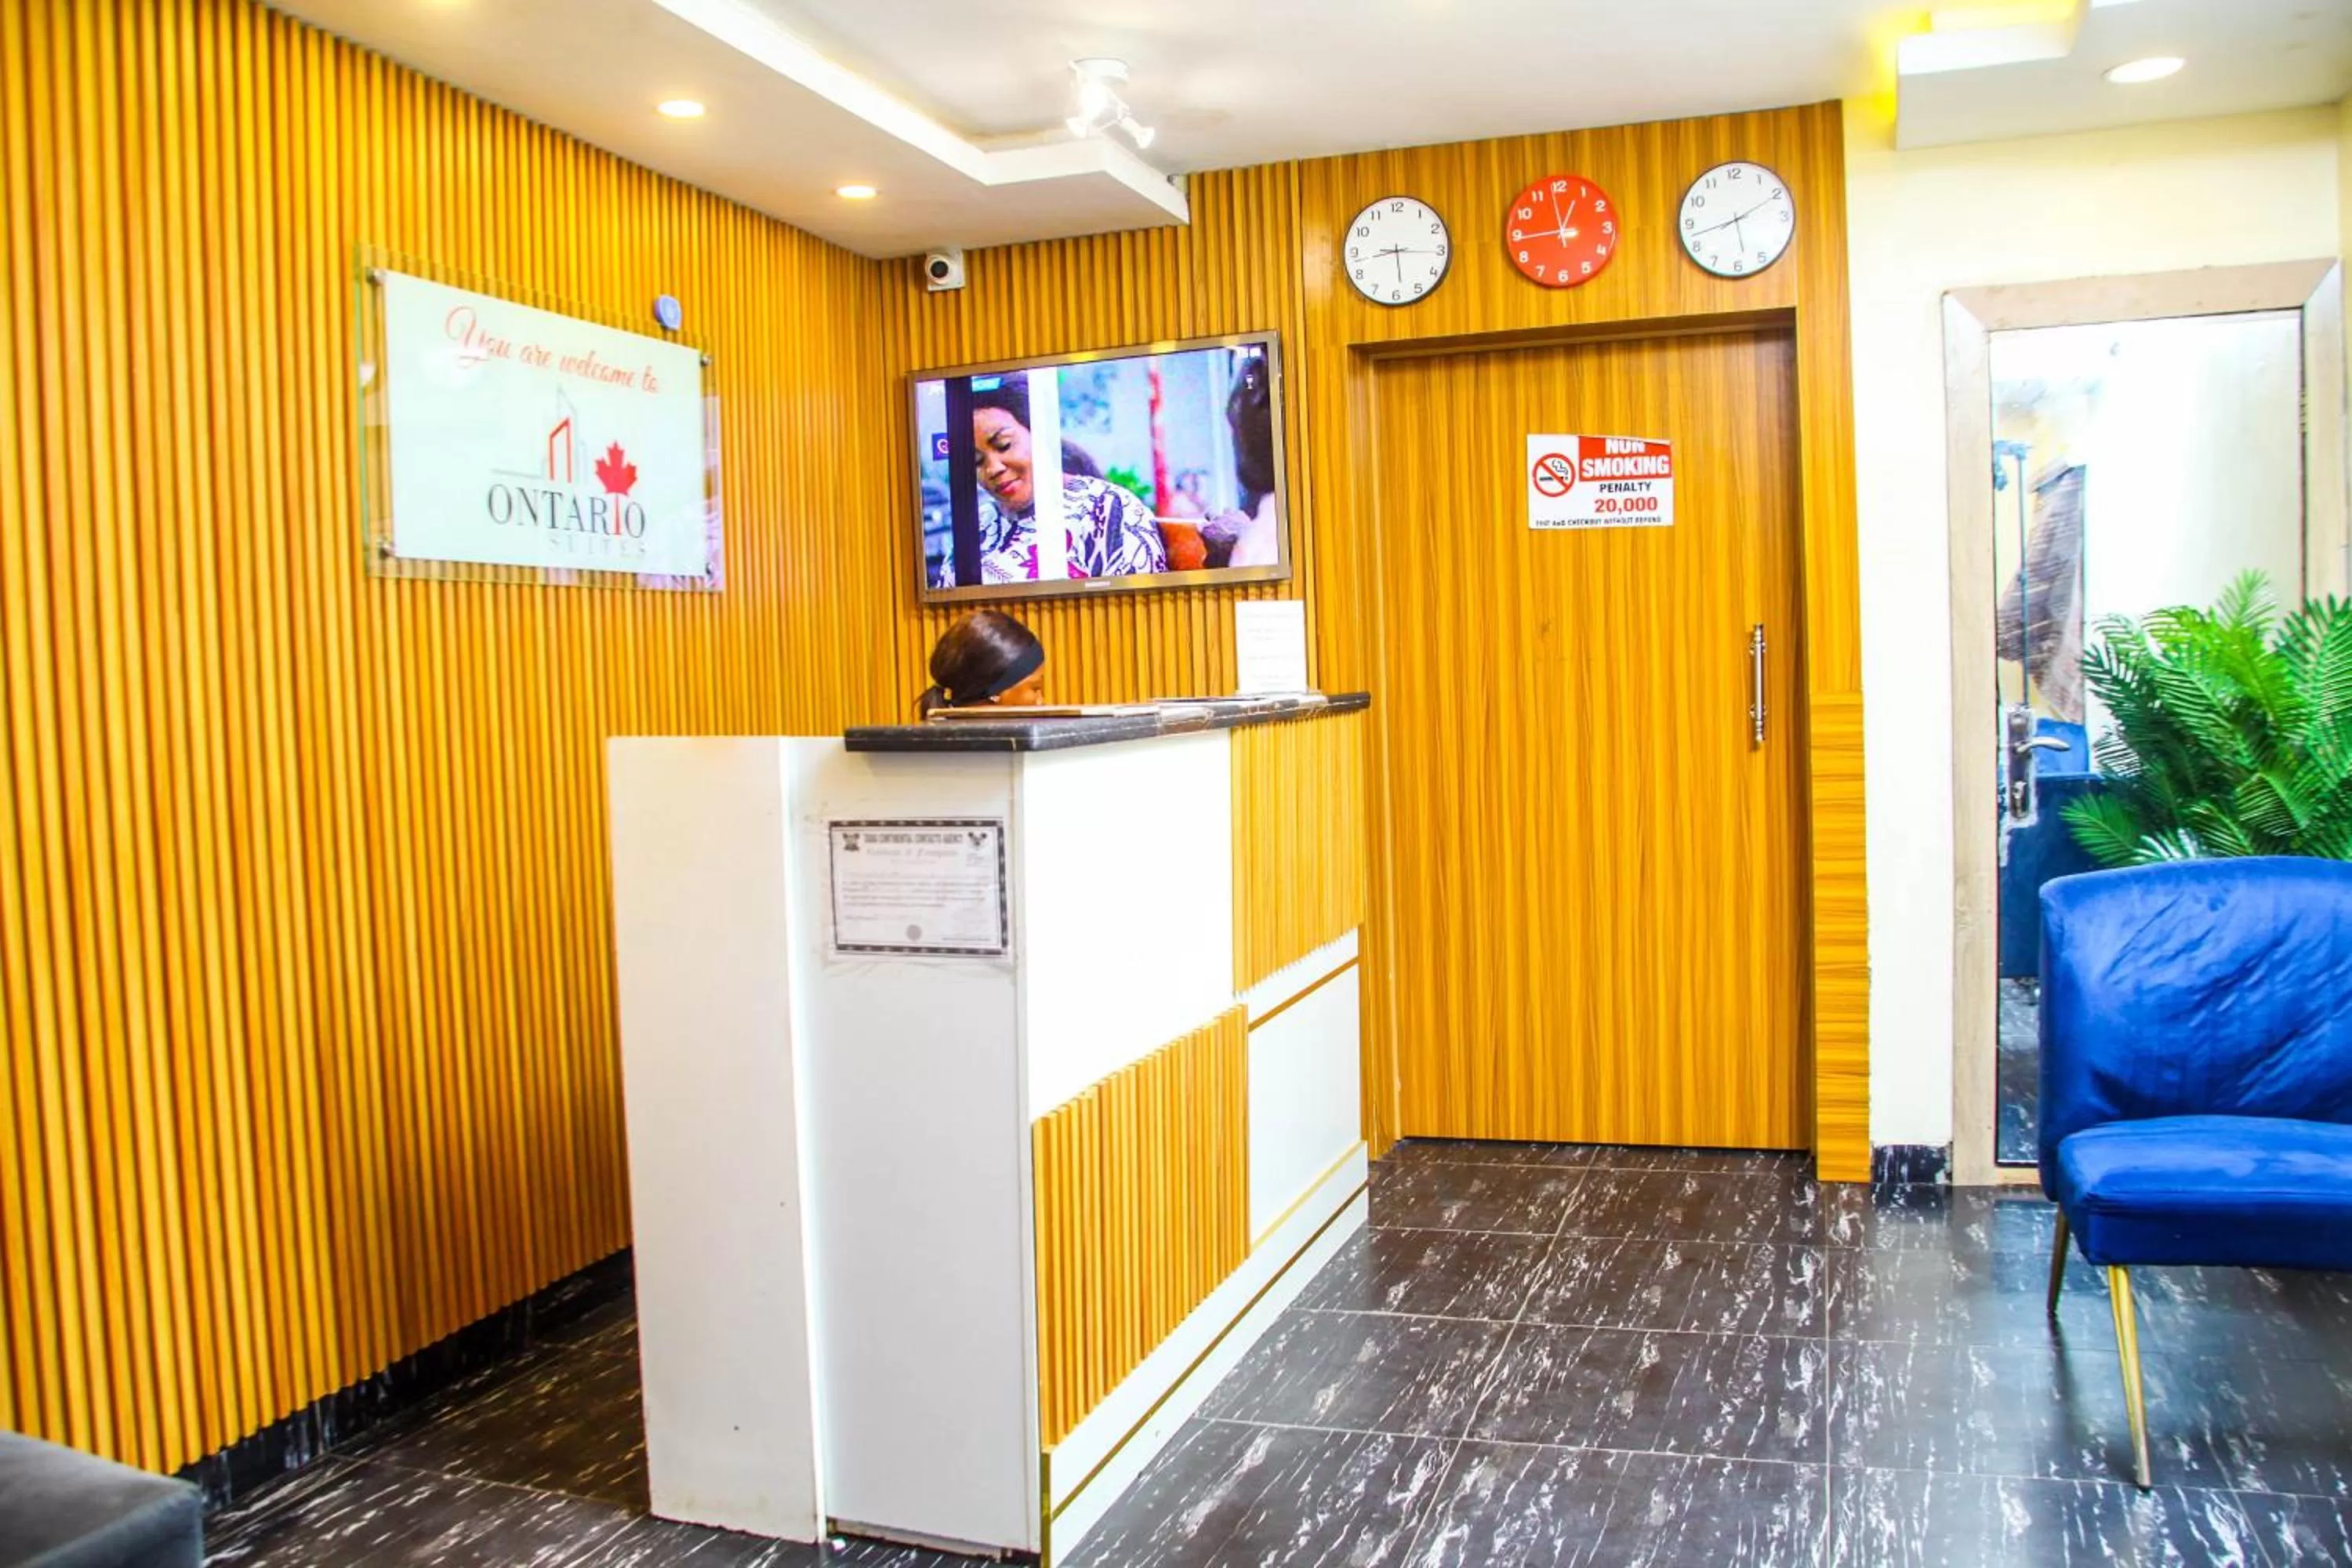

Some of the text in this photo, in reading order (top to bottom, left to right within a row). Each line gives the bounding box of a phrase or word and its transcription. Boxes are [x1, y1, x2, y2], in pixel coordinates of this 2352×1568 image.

[1726, 167, 1741, 180] 12
[1705, 177, 1717, 189] 11
[1756, 174, 1762, 186] 1
[1552, 180, 1568, 193] 12
[1581, 185, 1586, 198] 1
[1531, 190, 1544, 203] 11
[1773, 188, 1782, 200] 2
[1391, 201, 1404, 212] 12
[1595, 200, 1606, 213] 2
[1690, 195, 1705, 208] 10
[1371, 210, 1381, 220] 11
[1417, 209, 1421, 220] 1
[1518, 207, 1533, 220] 10
[1780, 210, 1789, 223] 3
[1431, 223, 1440, 234] 2
[1602, 220, 1613, 234] 3
[1685, 218, 1693, 230] 9
[1356, 226, 1370, 238] 10
[1512, 228, 1523, 242] 9
[1349, 246, 1359, 258] 9
[1436, 245, 1446, 256] 3
[1595, 244, 1606, 256] 4
[1693, 240, 1700, 252] 8
[1519, 250, 1529, 263] 8
[1710, 255, 1719, 267] 7
[1758, 252, 1766, 263] 5
[1534, 265, 1545, 277] 7
[1581, 261, 1592, 274] 5
[1733, 260, 1743, 272] 6
[1356, 269, 1363, 279] 8
[1429, 267, 1438, 278] 4
[1558, 270, 1569, 283] 6
[1371, 283, 1379, 295] 7
[1414, 283, 1423, 294] 5
[1392, 289, 1401, 301] 6
[520, 343, 552, 366] are
[558, 350, 634, 387] welcome
[641, 363, 658, 392] to
[1581, 454, 1670, 478] SMOKING
[1599, 481, 1652, 493] PENALTY
[487, 483, 646, 539] ONTARIO
[1594, 496, 1658, 515] 20,000
[1567, 517, 1602, 526] CHECKOUT
